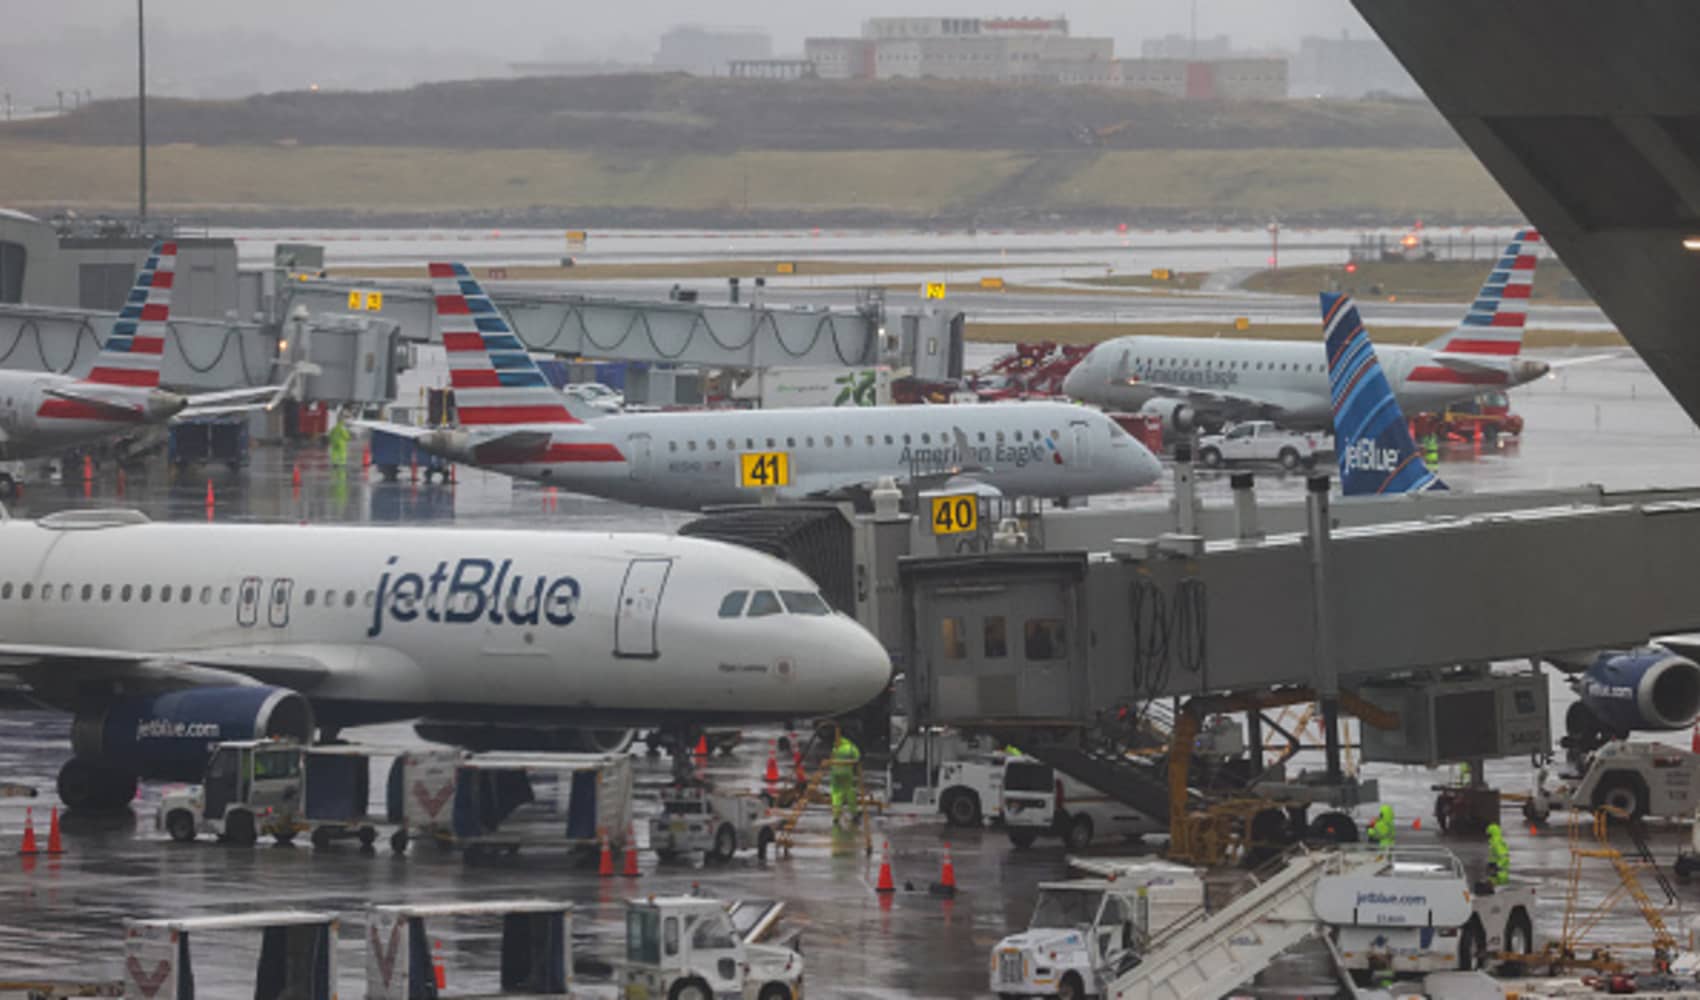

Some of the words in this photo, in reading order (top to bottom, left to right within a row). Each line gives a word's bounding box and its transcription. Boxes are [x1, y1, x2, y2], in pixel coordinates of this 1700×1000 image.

[751, 455, 780, 484] 41
[898, 446, 990, 465] Amerin
[996, 442, 1044, 468] Eagle
[1343, 436, 1399, 475] jetBlue
[936, 499, 973, 530] 40
[367, 555, 581, 638] jetBlue
[136, 718, 220, 741] jetblue.com
[1357, 890, 1426, 907] jetblue.com
